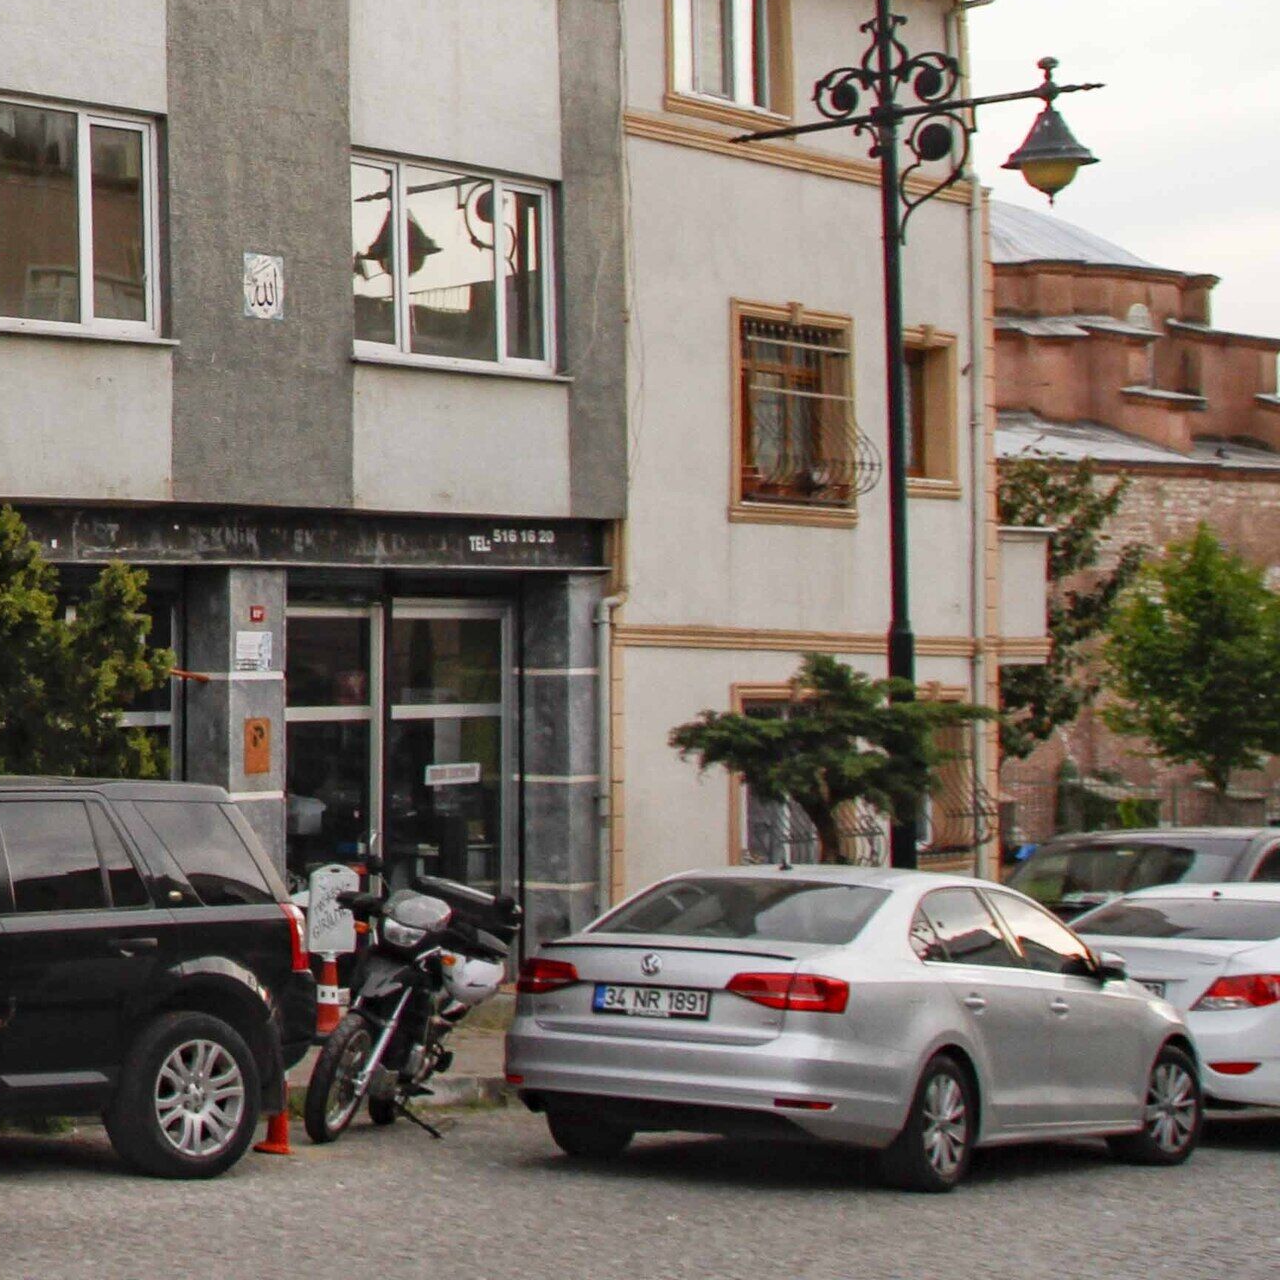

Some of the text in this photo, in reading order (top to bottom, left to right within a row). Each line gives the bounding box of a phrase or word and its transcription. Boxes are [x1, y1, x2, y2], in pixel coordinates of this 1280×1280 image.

[469, 535, 491, 552] TEL:
[493, 529, 517, 543] 516
[521, 530, 536, 543] 16
[605, 987, 707, 1012] 34 NR 1891
